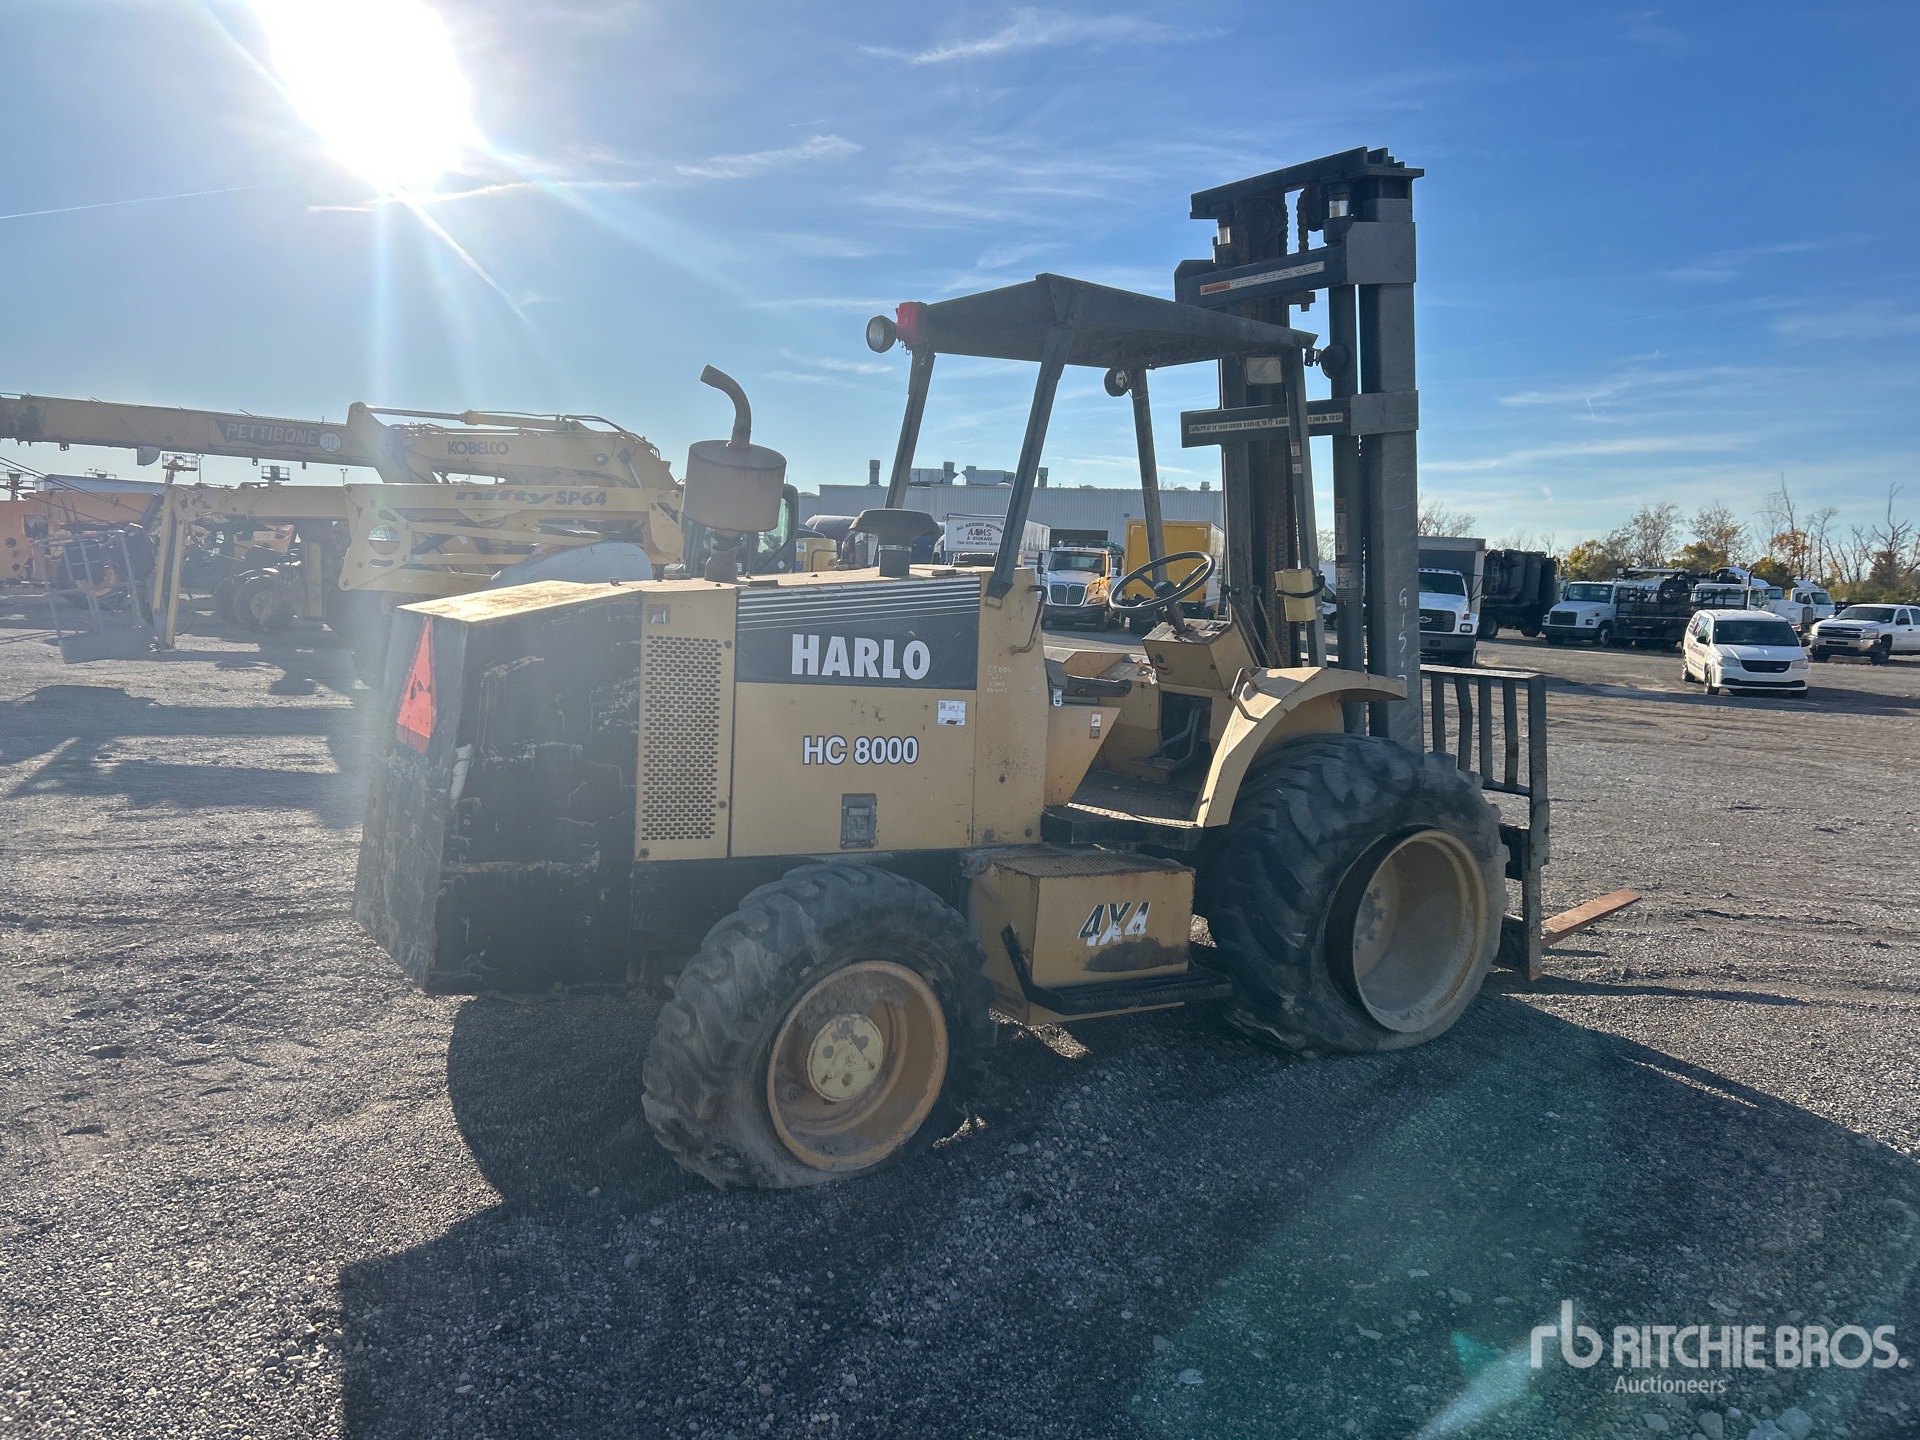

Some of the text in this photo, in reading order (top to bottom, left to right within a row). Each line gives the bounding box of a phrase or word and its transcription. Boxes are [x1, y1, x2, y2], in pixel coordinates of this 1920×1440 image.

[225, 422, 318, 444] PETTIBONE
[447, 440, 509, 455] KOBELCO
[454, 489, 607, 506] nifty SP64
[791, 633, 931, 680] HARLO
[803, 735, 920, 766] HC 8000
